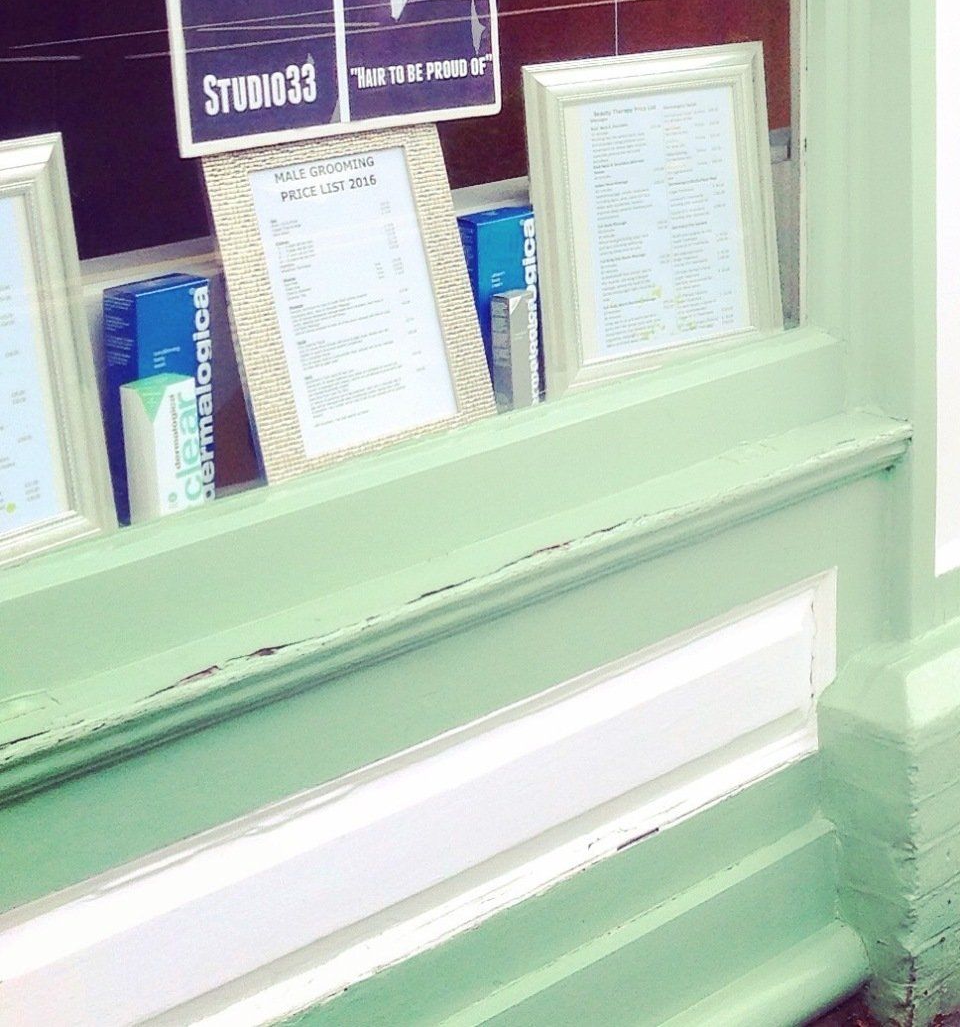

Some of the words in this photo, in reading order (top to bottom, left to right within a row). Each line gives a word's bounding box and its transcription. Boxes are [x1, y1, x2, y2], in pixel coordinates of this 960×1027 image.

[389, 65, 405, 85] TO
[406, 62, 424, 83] BE
[426, 58, 467, 81] PROUD
[274, 168, 308, 184] MALE
[309, 156, 375, 178] GROOMING
[280, 185, 318, 202] PRICE
[320, 180, 346, 195] LIST
[348, 174, 377, 190] 2016
